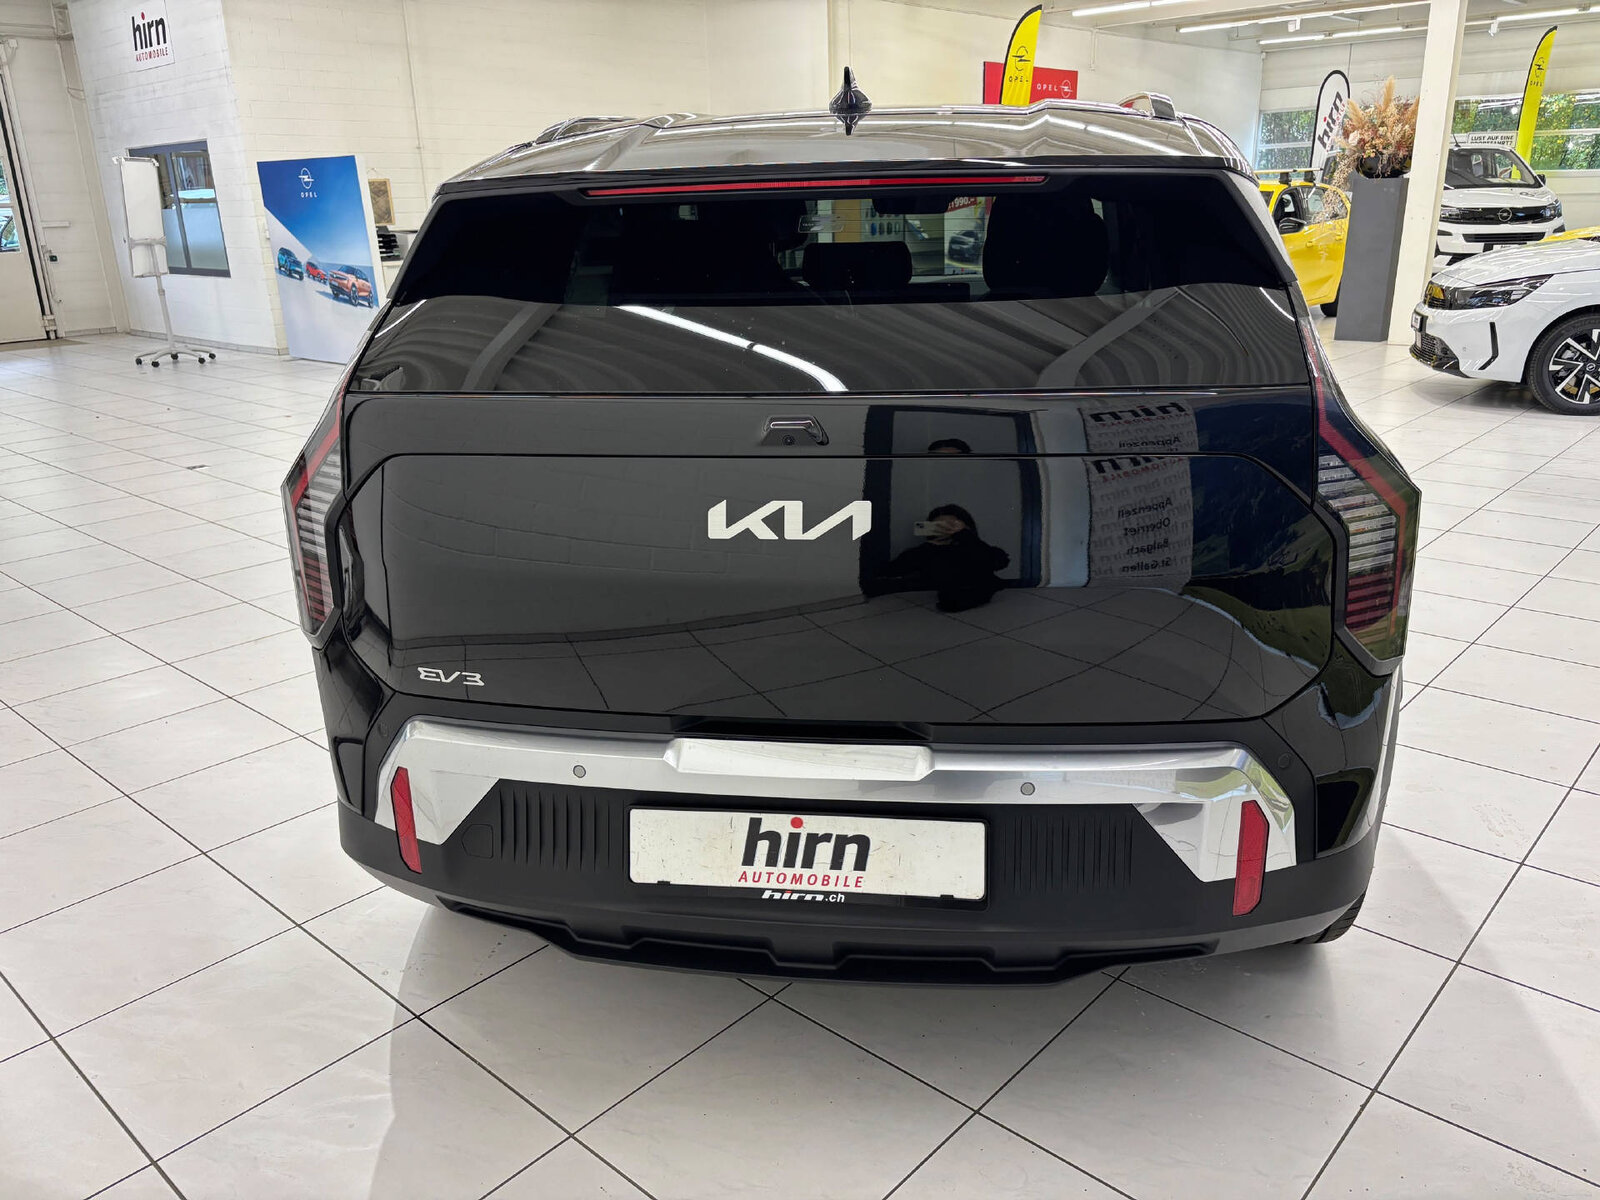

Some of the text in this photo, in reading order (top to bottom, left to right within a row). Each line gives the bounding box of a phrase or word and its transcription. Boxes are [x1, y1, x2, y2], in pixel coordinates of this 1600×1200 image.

[131, 11, 167, 51] hirn
[135, 47, 169, 62] AUTOMOBILE
[1036, 83, 1058, 92] OPEL
[1317, 91, 1343, 150] hirn
[708, 499, 872, 541] KIA
[417, 667, 485, 686] EV3
[741, 816, 870, 872] hirn
[738, 870, 864, 888] AUTOMOBILE
[761, 890, 845, 903] hirn.ch
